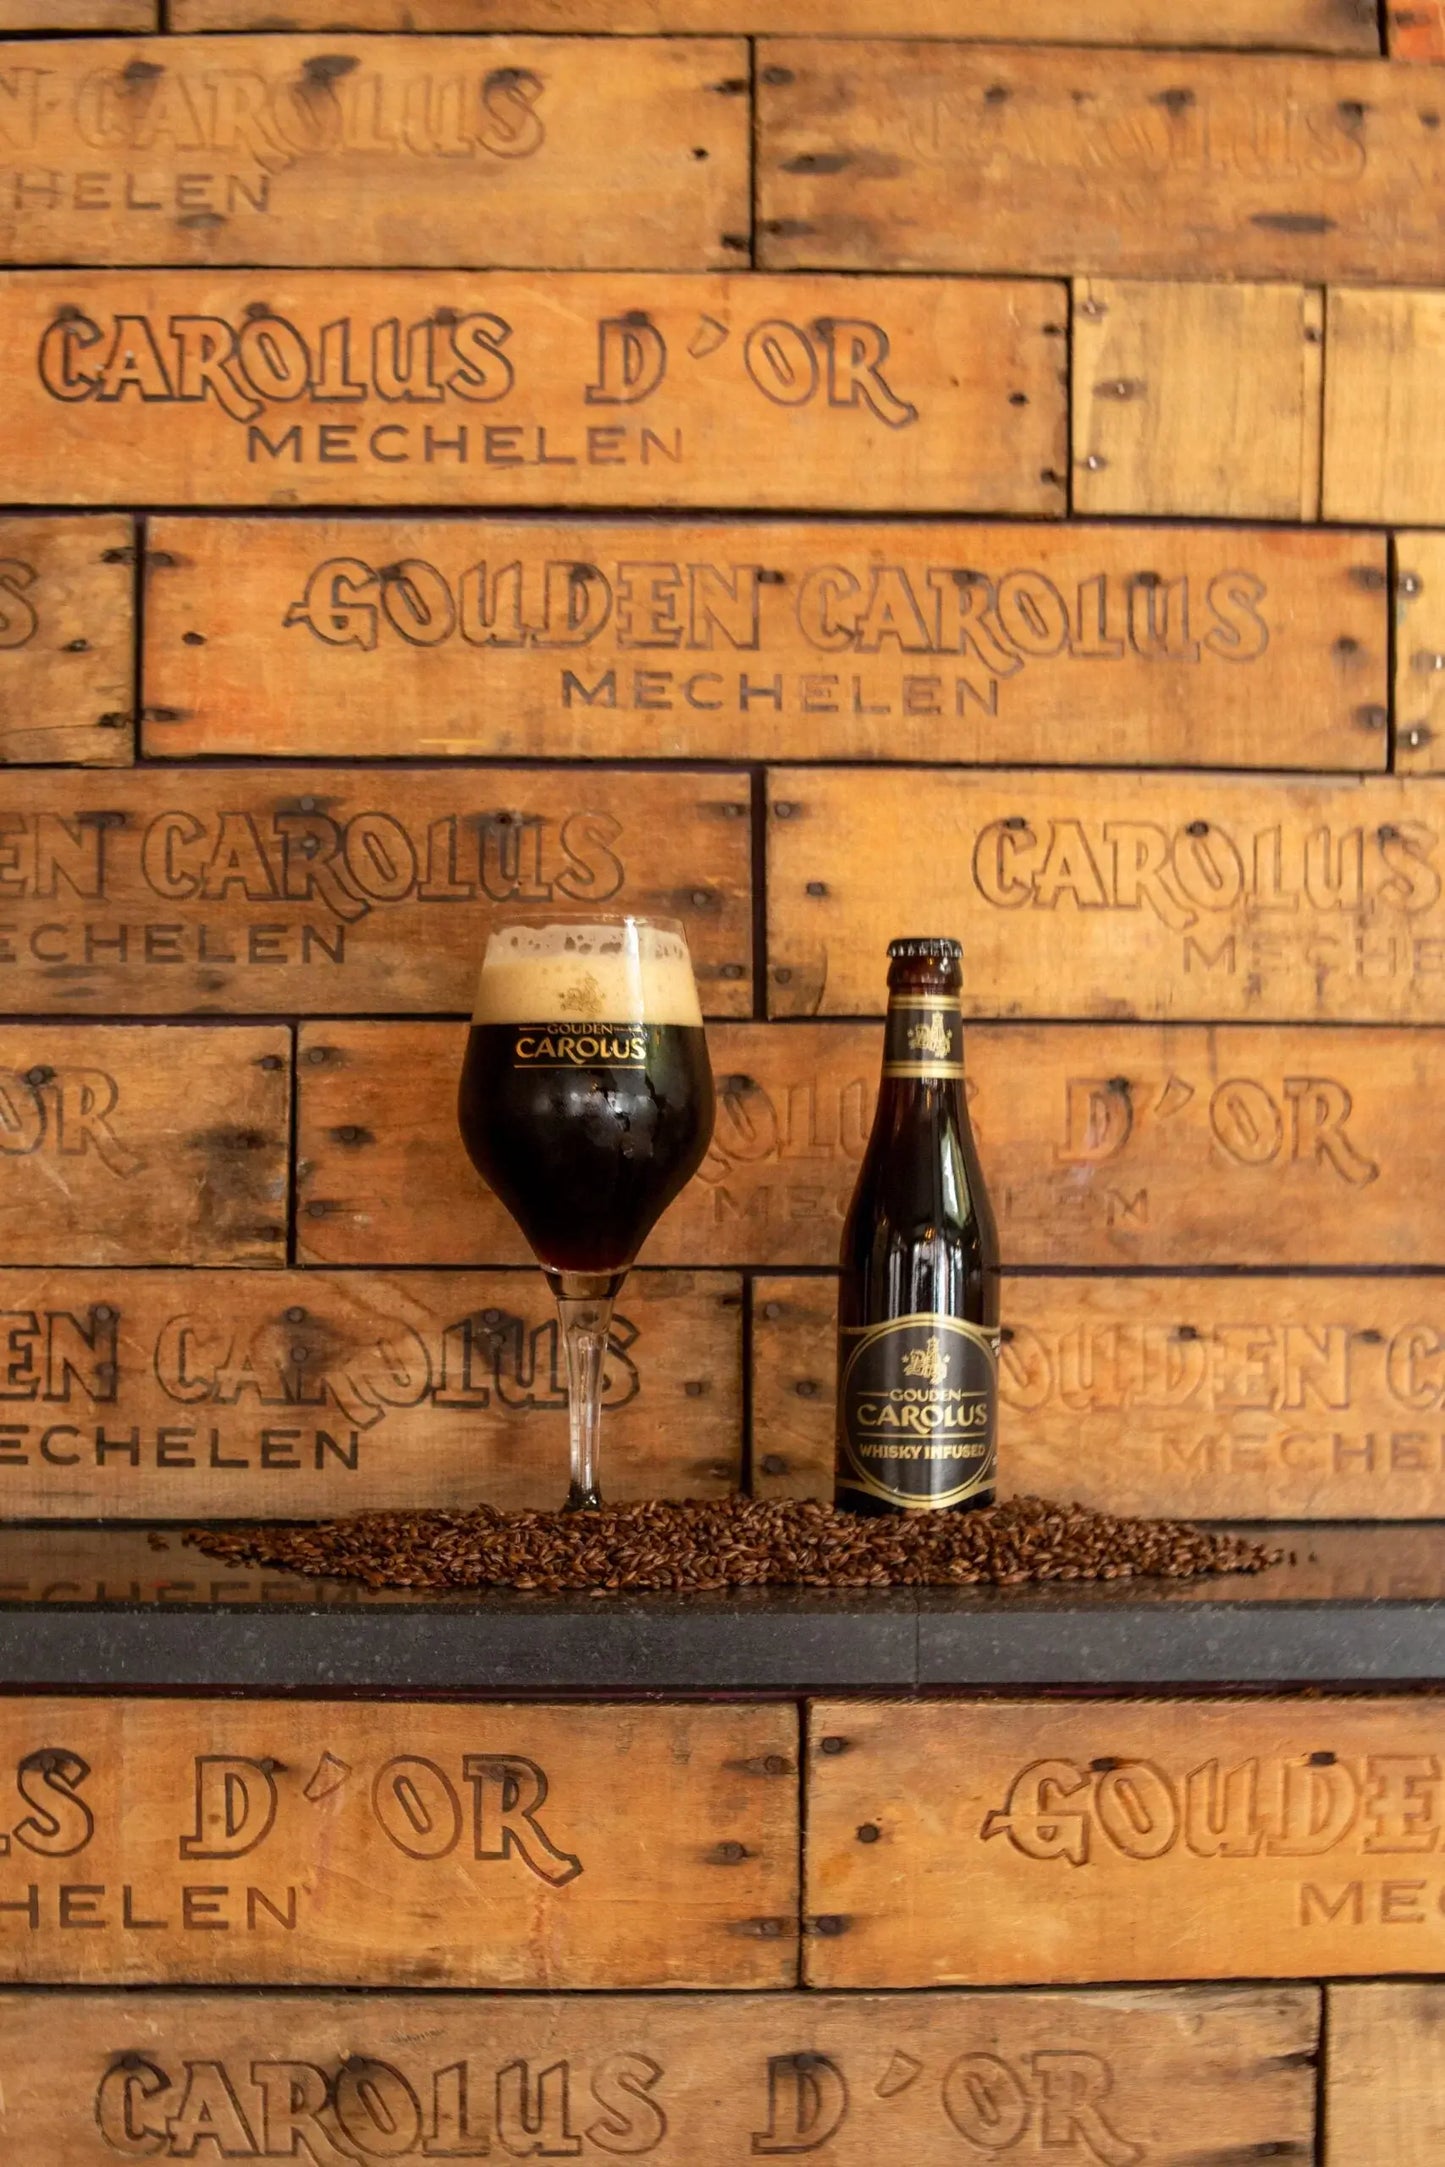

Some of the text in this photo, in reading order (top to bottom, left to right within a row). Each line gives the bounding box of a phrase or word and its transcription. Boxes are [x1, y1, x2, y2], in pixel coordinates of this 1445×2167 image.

[74, 66, 546, 176] CAROLUS
[14, 172, 268, 212] HELEN
[38, 309, 514, 423] CAROLUS
[248, 425, 683, 465] MECHELEN
[283, 556, 1269, 676] GOUDEN CAROLUS
[562, 669, 999, 718] MECHELEN
[141, 809, 624, 923] CAROLUS
[971, 817, 1443, 932] CAROLUS
[515, 1036, 647, 1065] CAROLUS
[546, 1022, 615, 1036] GOUDEN
[999, 1322, 1352, 1413] OUDEN
[856, 1402, 988, 1435] CAROLUS
[889, 1388, 962, 1402] GOUDEN
[859, 1443, 986, 1460] WHISKY INFUSED
[1160, 1430, 1445, 1474] MECHE
[980, 1754, 1445, 1867] GOUDE
[1301, 1879, 1445, 1928] ME
[94, 2050, 669, 2167] CAROLUS
